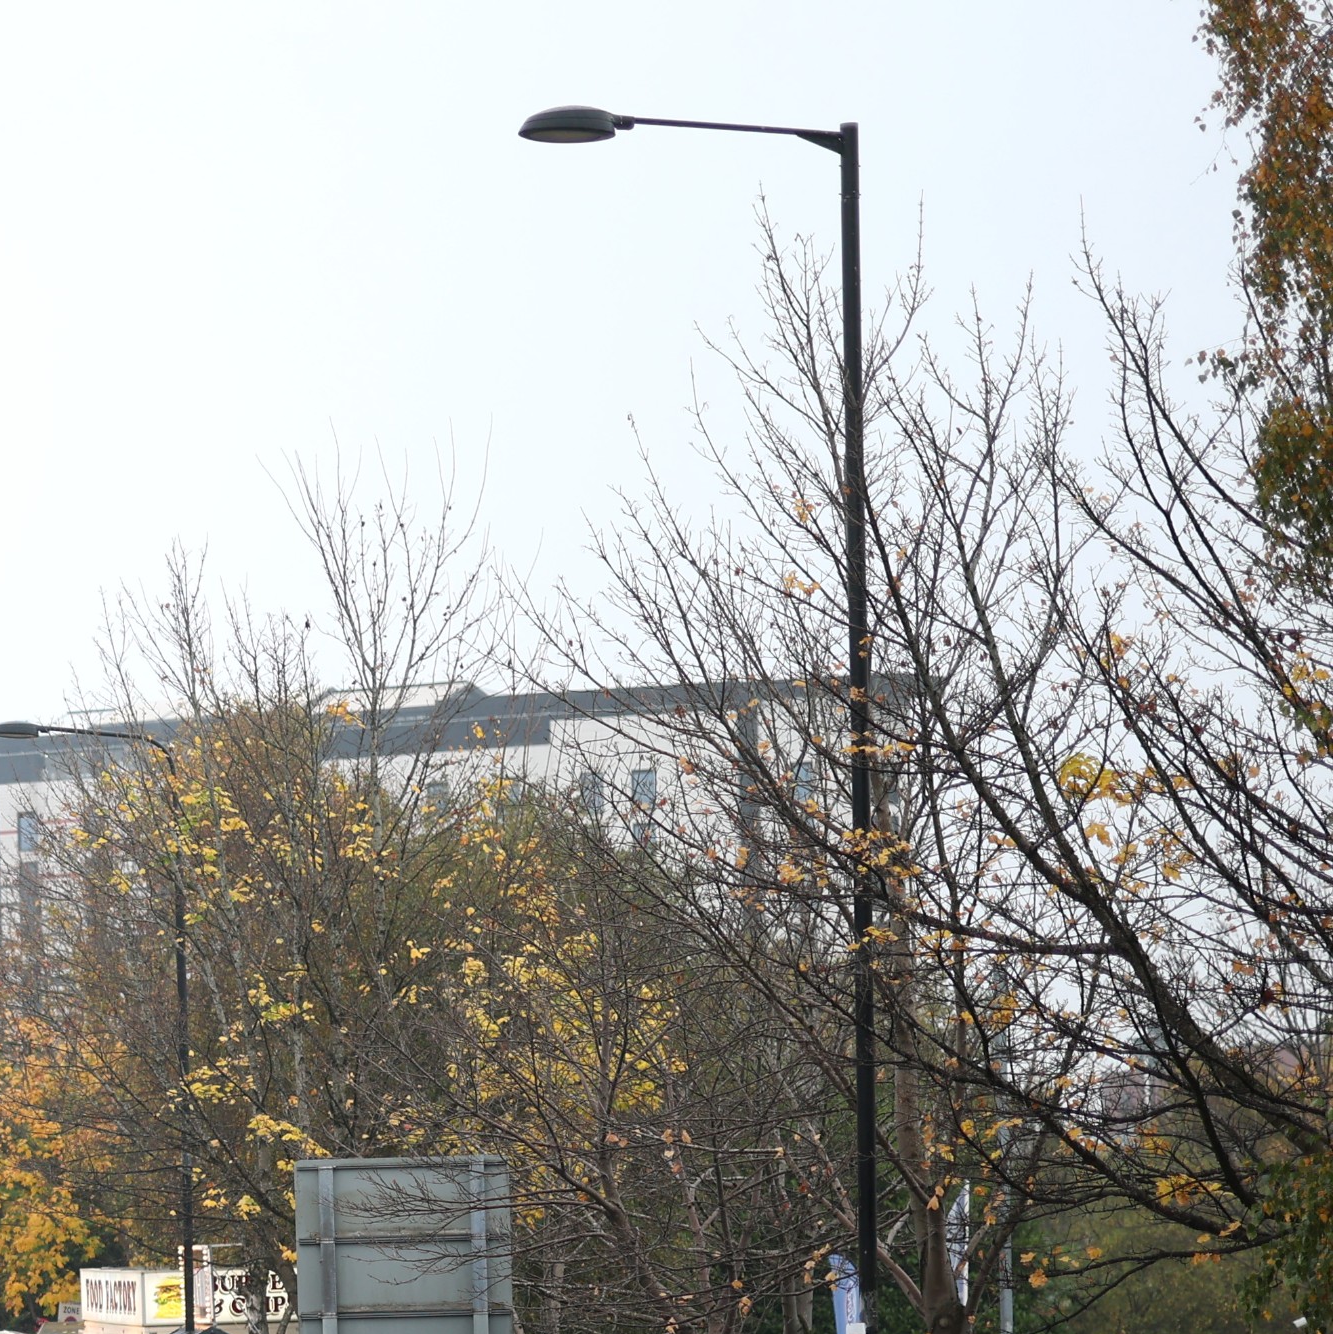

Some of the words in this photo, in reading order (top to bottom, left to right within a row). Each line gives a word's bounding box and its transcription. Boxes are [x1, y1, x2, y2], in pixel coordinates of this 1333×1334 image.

[85, 1279, 103, 1312] FOOD
[105, 1280, 137, 1315] FACTORY
[63, 1305, 80, 1315] ZONE
